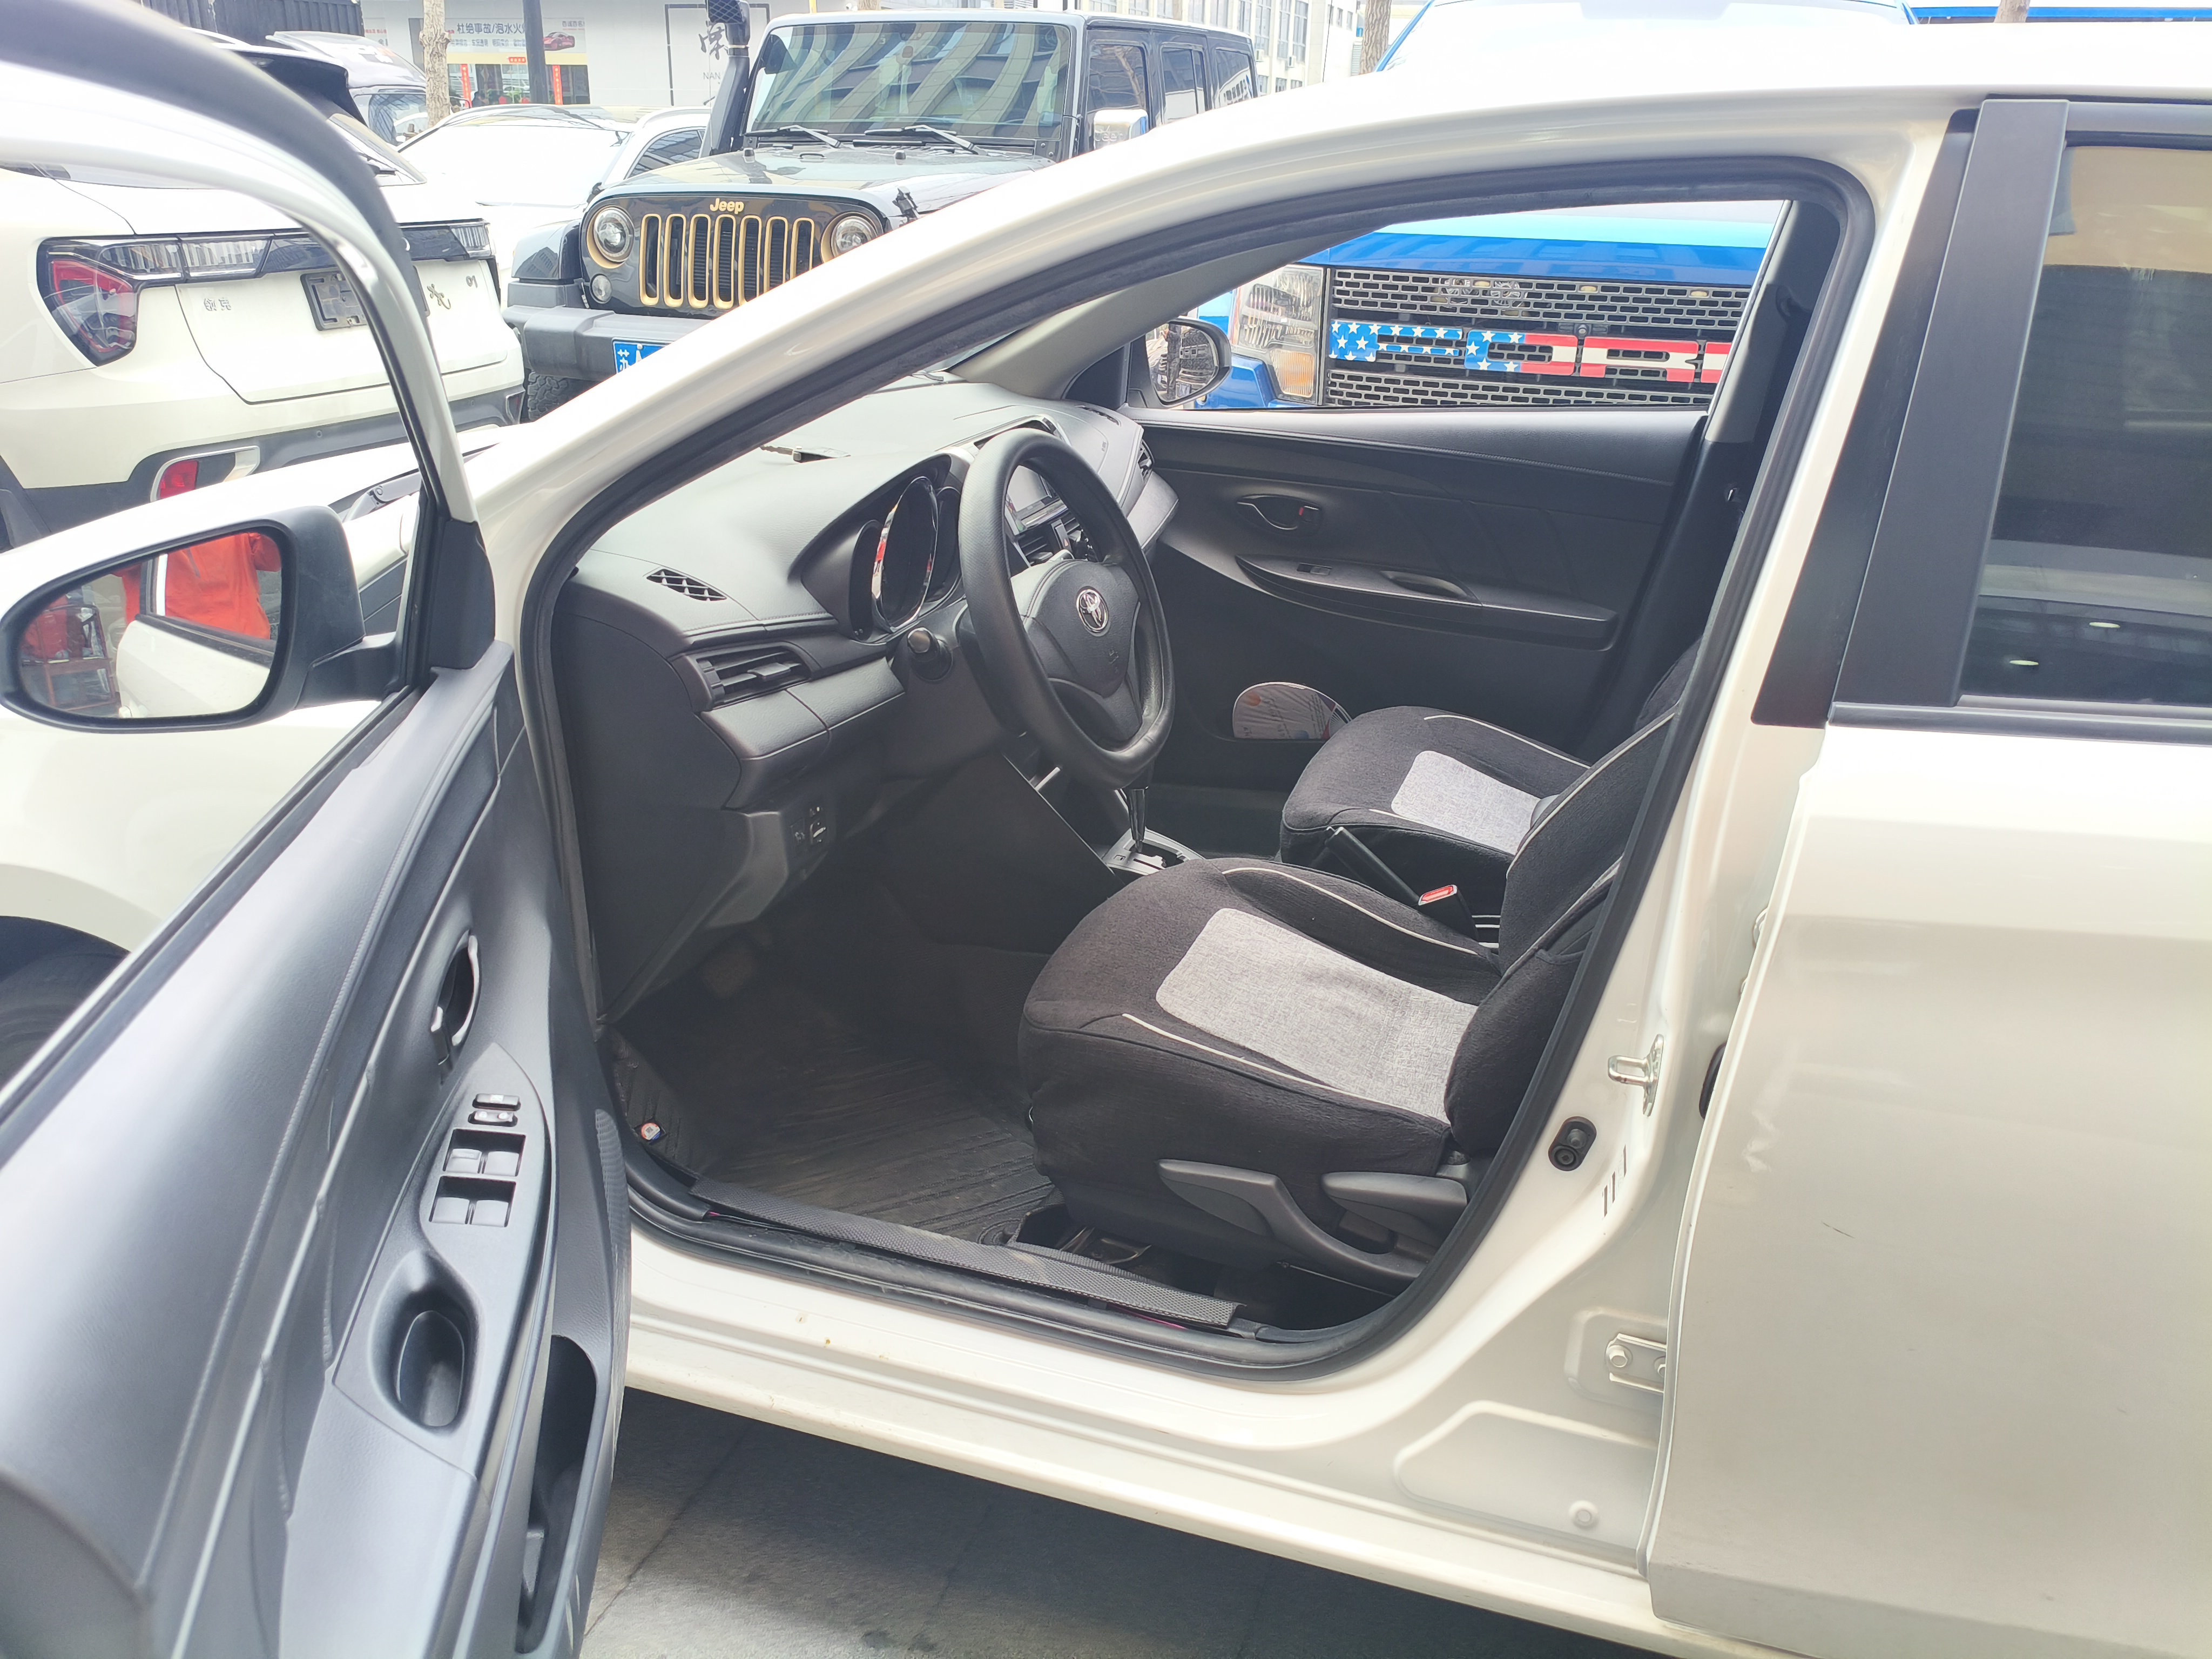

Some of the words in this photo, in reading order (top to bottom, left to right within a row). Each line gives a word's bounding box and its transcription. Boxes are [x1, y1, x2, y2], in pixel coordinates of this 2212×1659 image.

[710, 198, 744, 214] Jeep
[466, 275, 478, 288] 01
[1329, 319, 1732, 383] FOR
